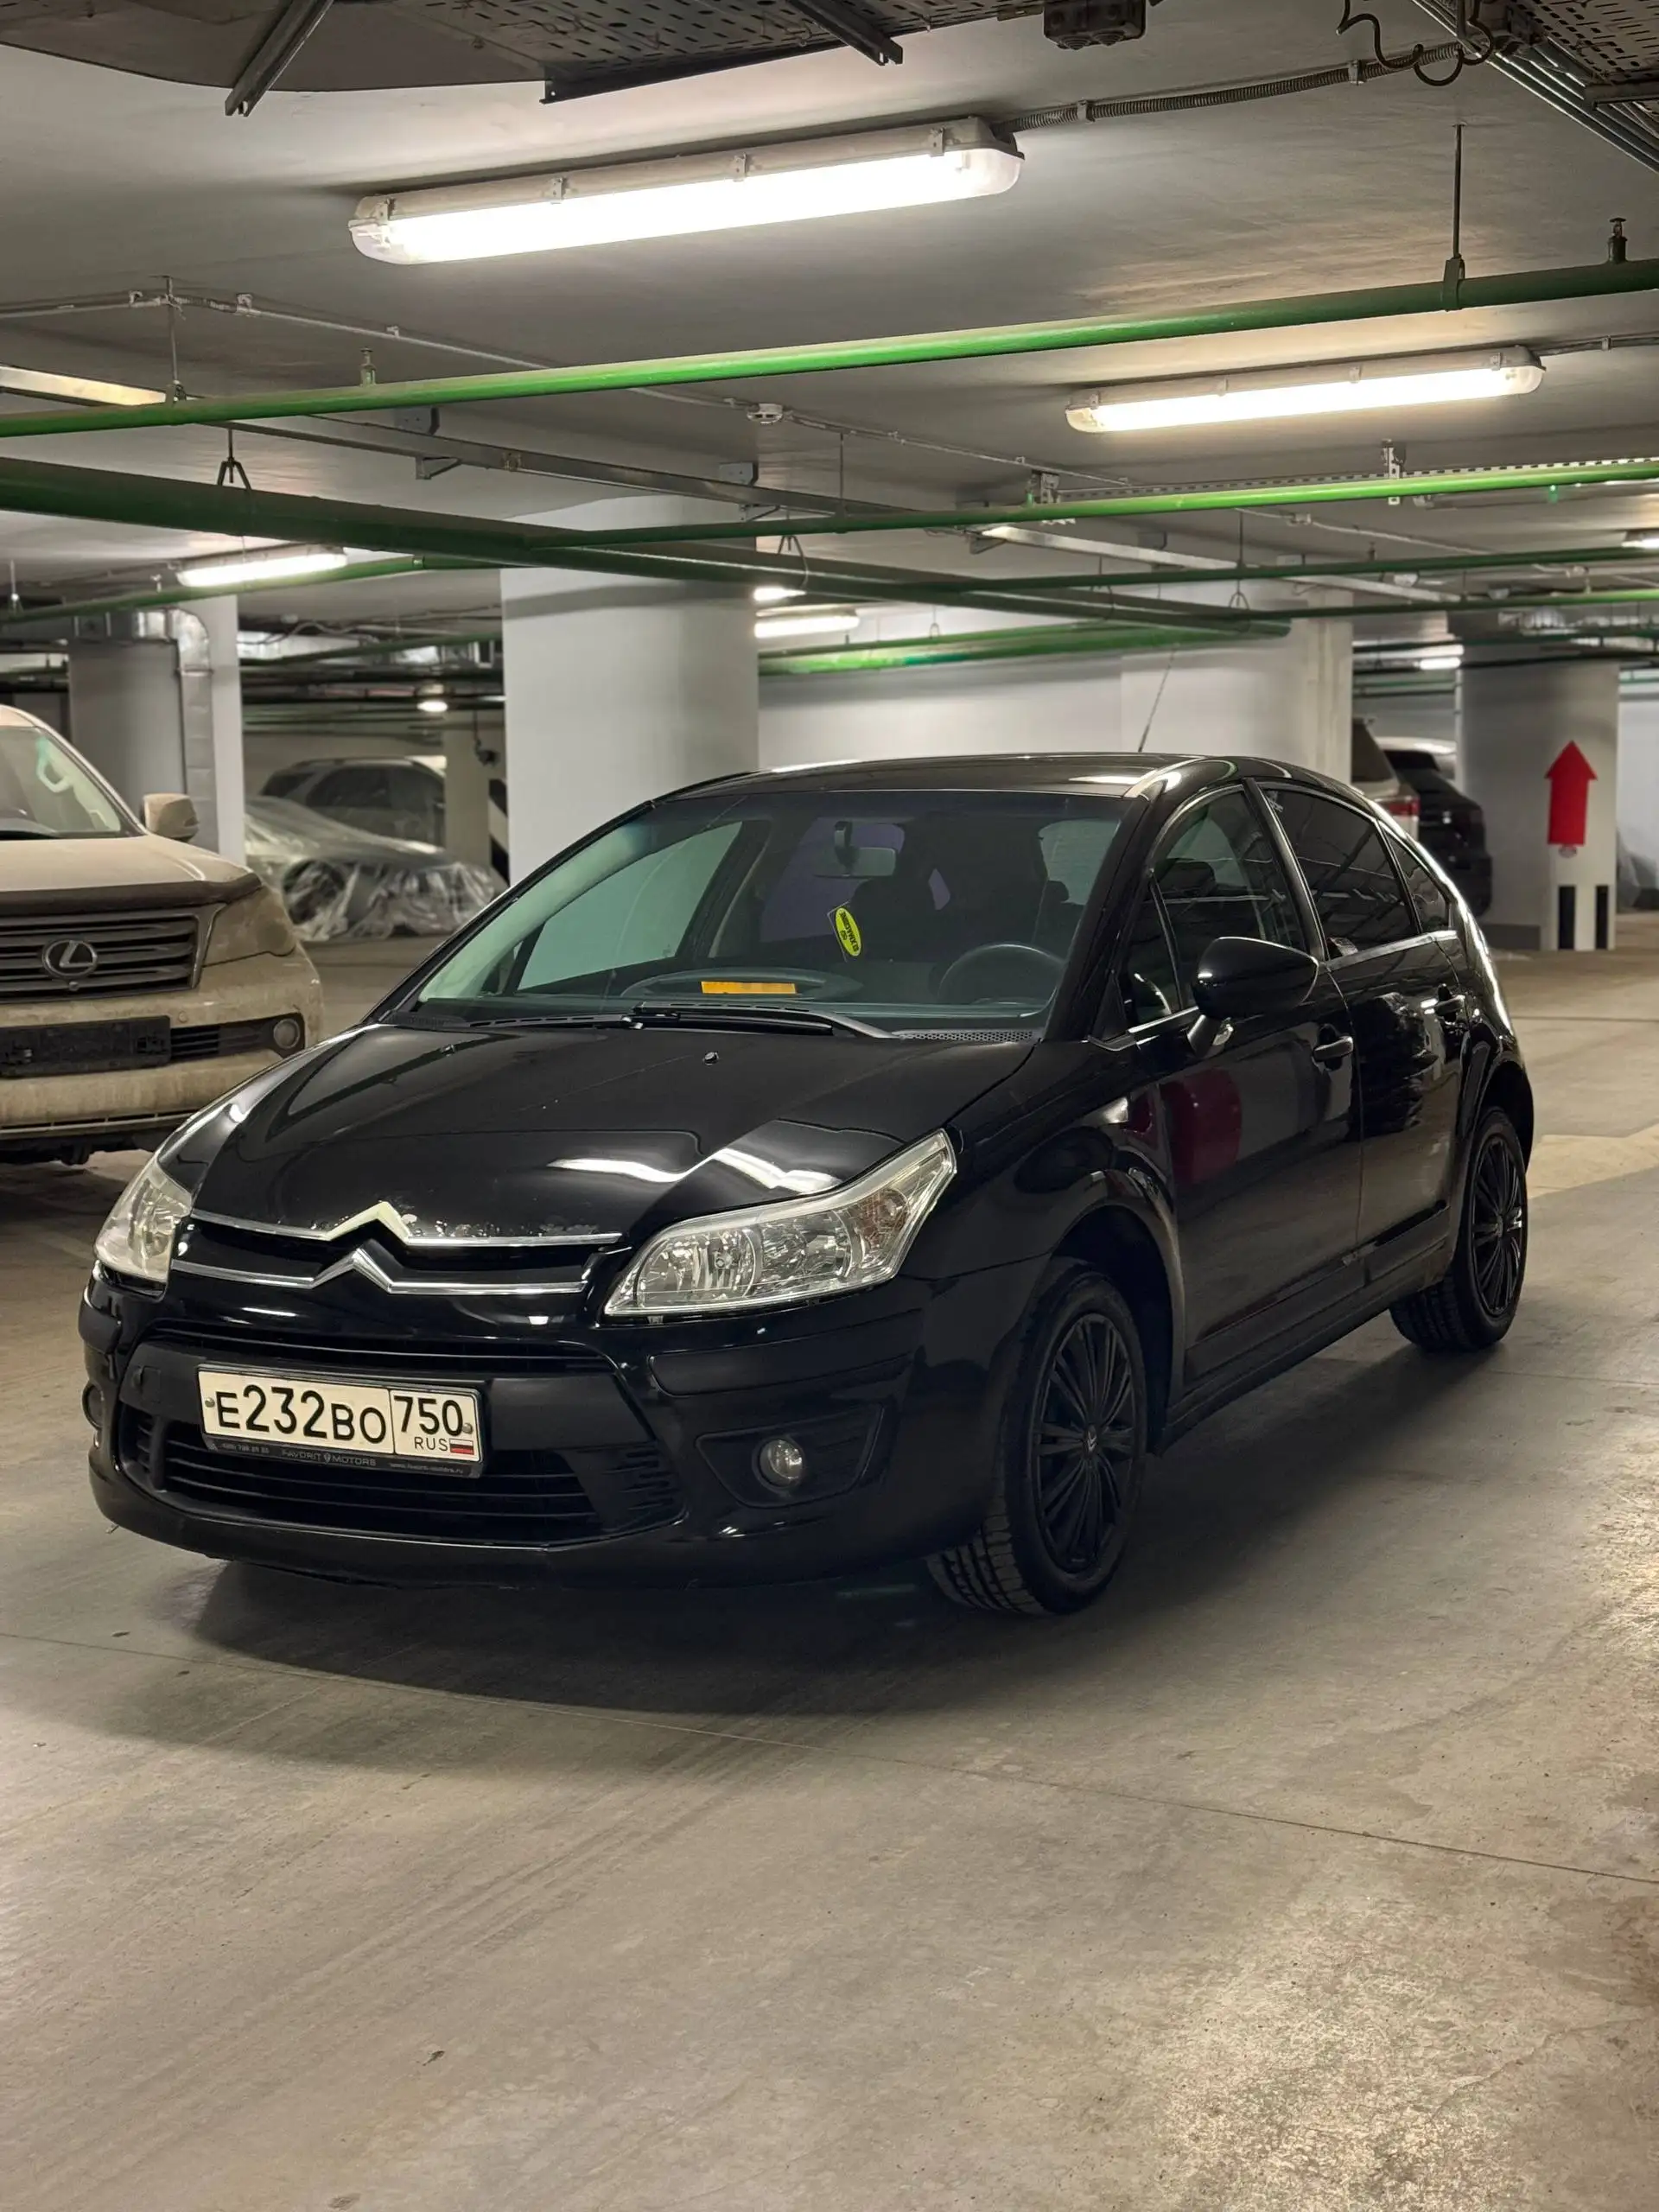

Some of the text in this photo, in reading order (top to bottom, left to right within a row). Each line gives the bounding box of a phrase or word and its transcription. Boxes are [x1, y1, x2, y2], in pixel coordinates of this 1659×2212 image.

[215, 1384, 464, 1444] Е232ВО 750
[414, 1437, 448, 1452] RUS
[282, 1449, 377, 1466] FAVORIT MOTORS
